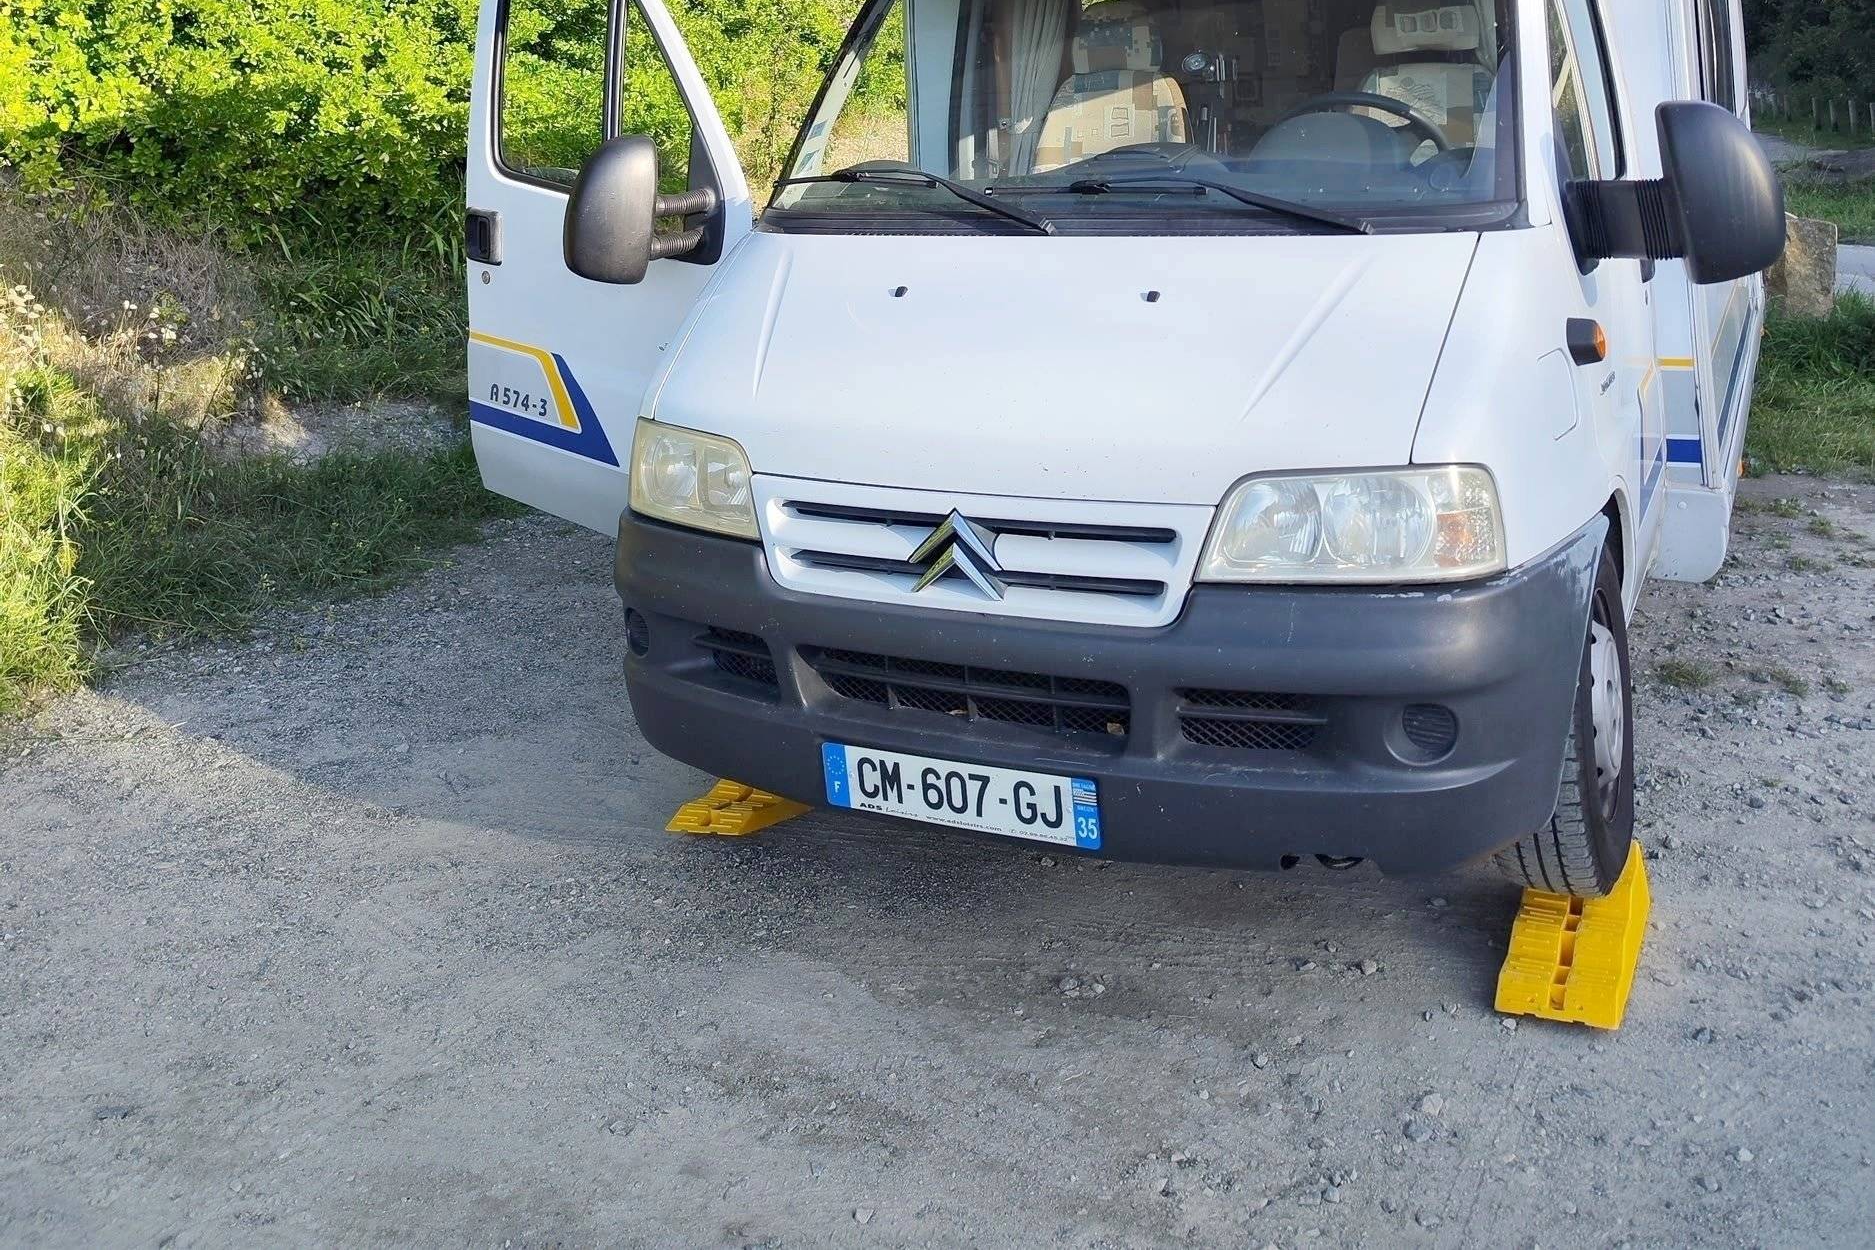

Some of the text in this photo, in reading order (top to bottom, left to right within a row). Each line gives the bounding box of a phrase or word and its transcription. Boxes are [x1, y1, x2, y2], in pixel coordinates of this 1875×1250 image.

[489, 383, 548, 417] A 574-3
[833, 781, 841, 794] F
[856, 756, 1064, 830] CM-607-GJ
[859, 802, 883, 811] ADS
[1077, 816, 1098, 840] 35
